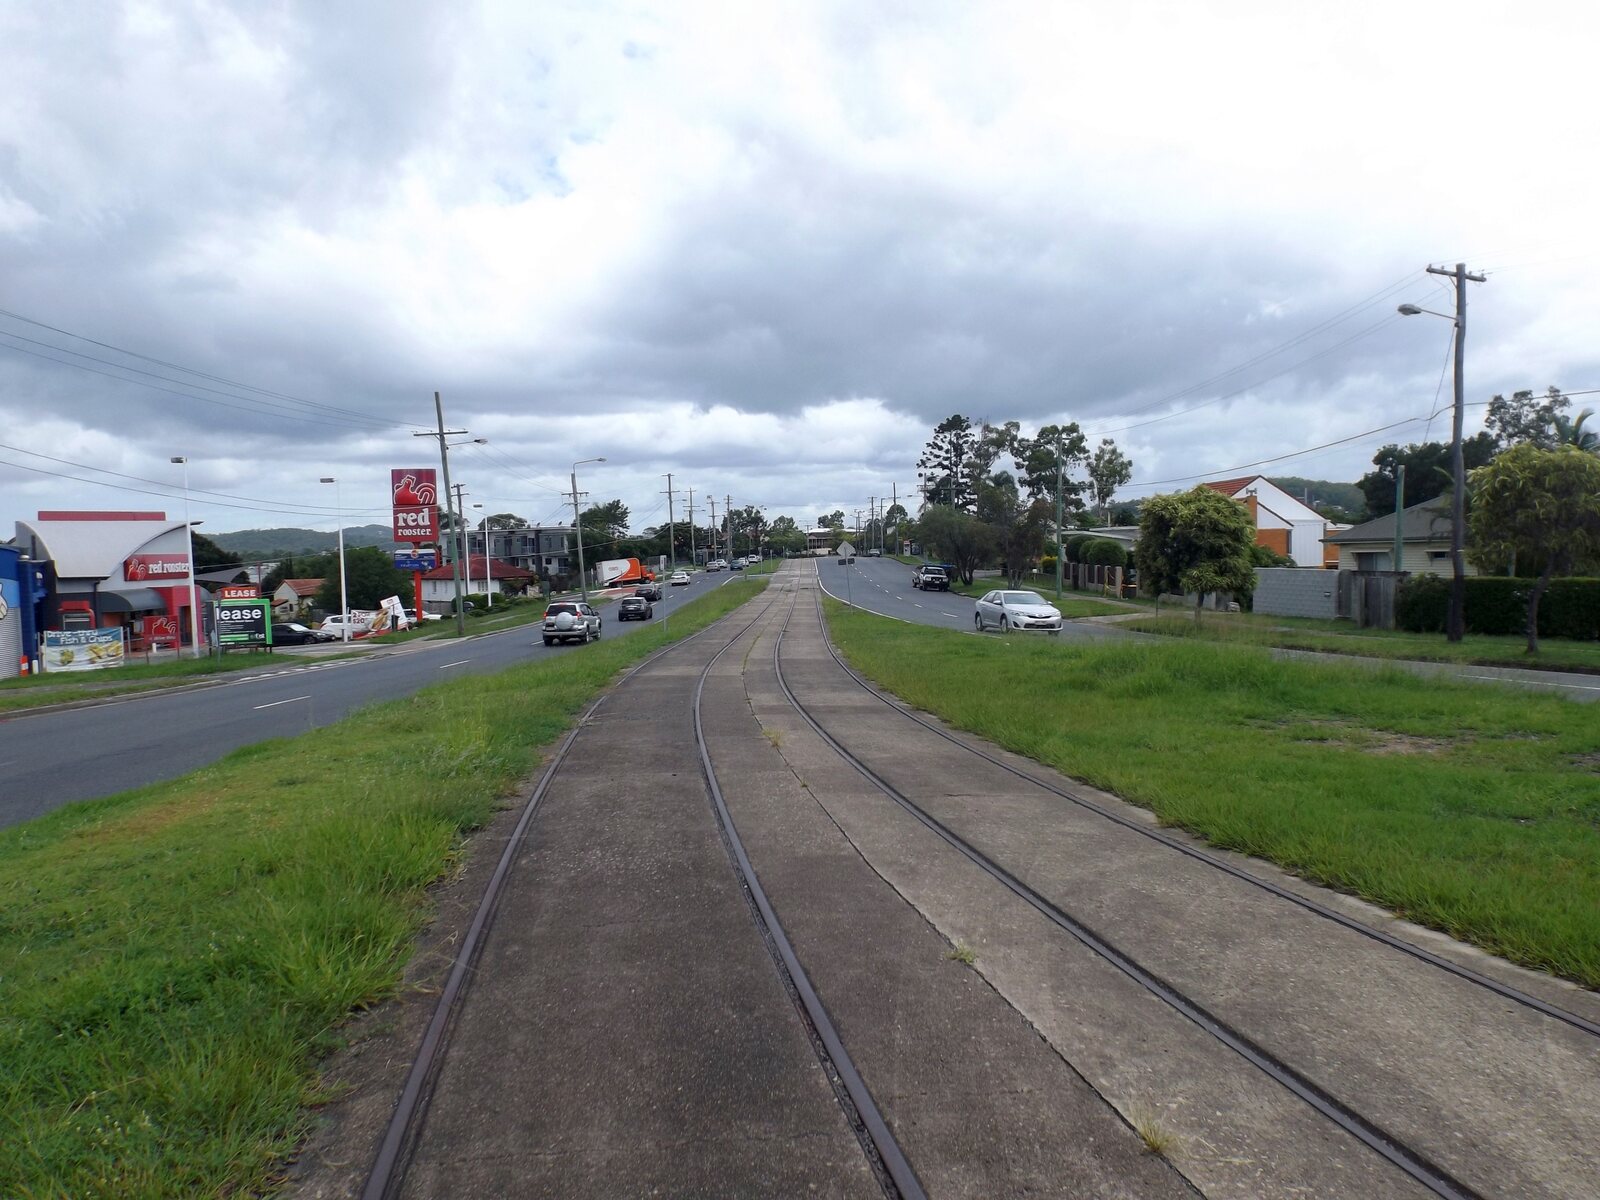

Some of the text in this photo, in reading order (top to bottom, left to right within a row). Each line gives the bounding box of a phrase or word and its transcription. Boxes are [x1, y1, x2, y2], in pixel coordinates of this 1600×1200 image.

[397, 508, 430, 526] red
[398, 528, 431, 536] rooster
[148, 561, 162, 574] red
[224, 590, 256, 598] LEASE
